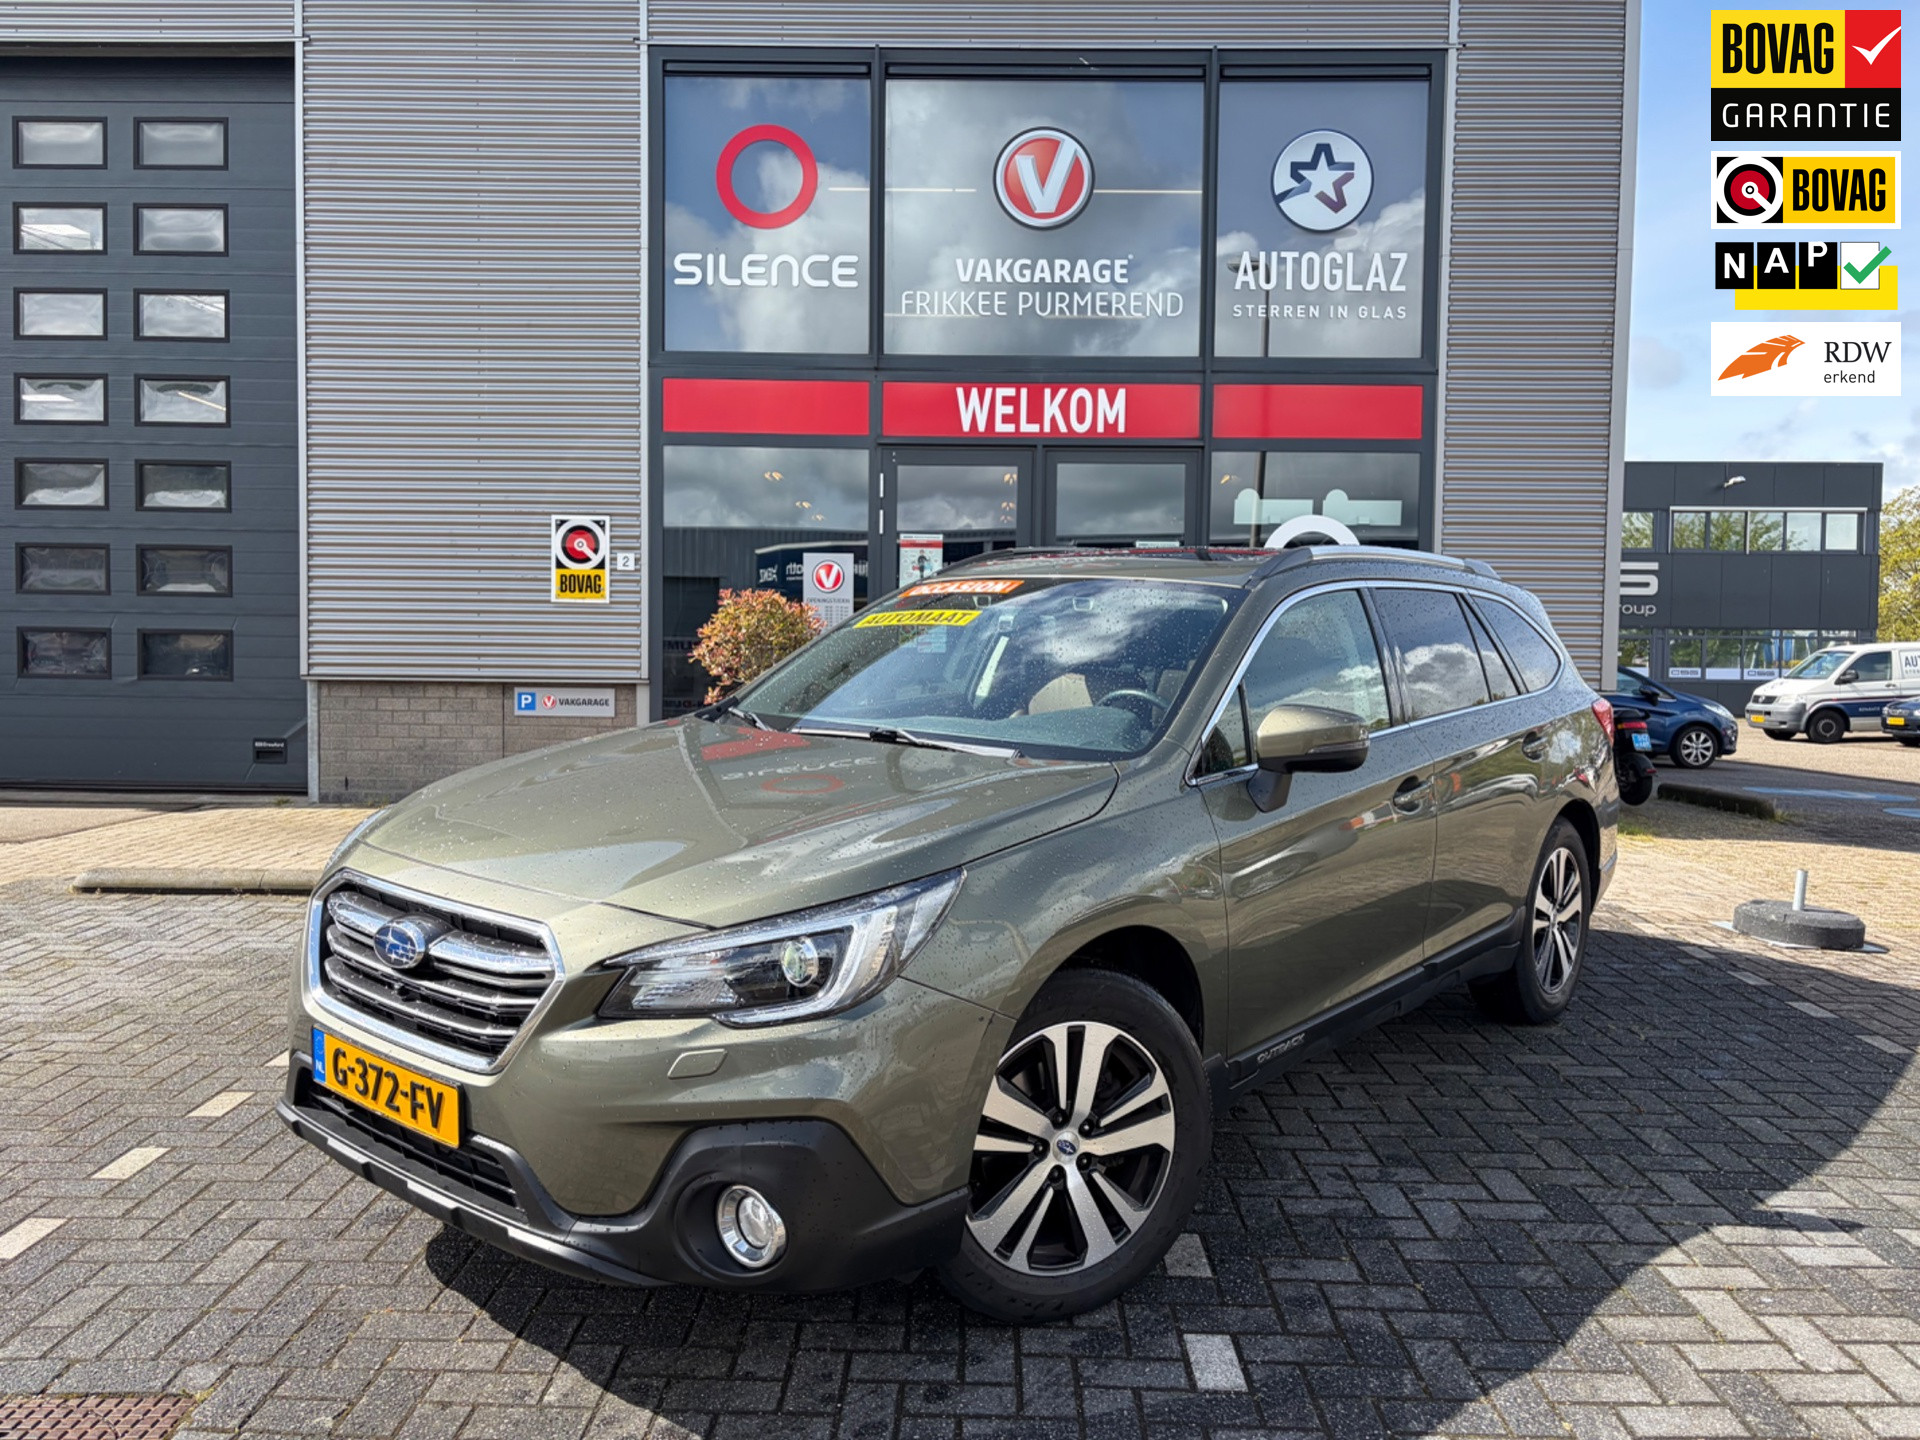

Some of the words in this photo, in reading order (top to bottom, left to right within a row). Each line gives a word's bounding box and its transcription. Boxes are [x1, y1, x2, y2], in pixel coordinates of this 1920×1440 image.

[673, 253, 859, 288] SILENCE
[956, 258, 1129, 283] VAKGARAGE
[1234, 251, 1408, 292] AUTOGLAZ
[900, 291, 1007, 316] FRIKKEE
[1018, 292, 1183, 317] PURMEREND
[1233, 304, 1319, 318] STERREN
[1330, 305, 1348, 318] IN
[1358, 306, 1407, 320] GLAS
[956, 387, 1126, 433] WELKOM
[622, 556, 630, 567] 2
[560, 573, 602, 594] BOVAG
[862, 611, 973, 626] AUTOMAAT
[1619, 604, 1657, 617] oup
[559, 698, 610, 707] VAKGARAGE
[316, 1059, 324, 1073] NL
[333, 1047, 443, 1129] G-372-FV
